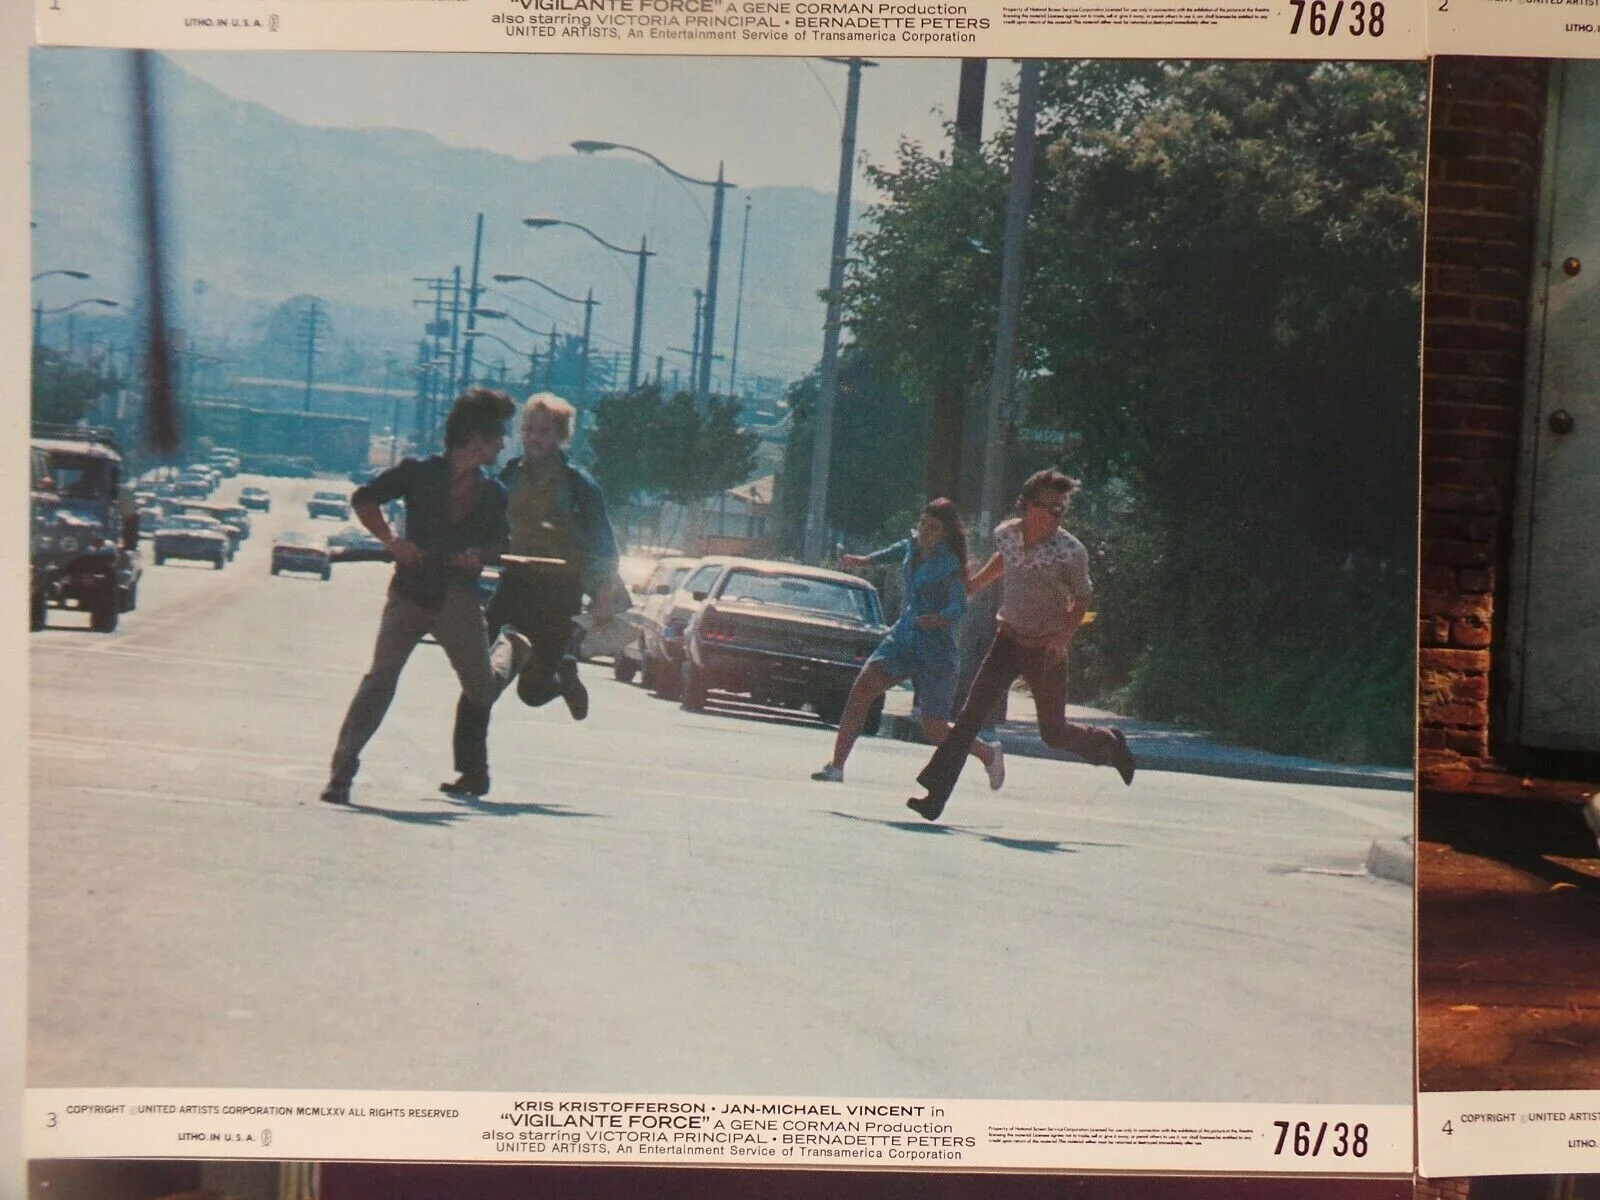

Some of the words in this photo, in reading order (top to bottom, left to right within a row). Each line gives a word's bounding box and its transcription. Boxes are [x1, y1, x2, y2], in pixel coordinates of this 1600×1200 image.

[726, 3, 738, 13] A
[743, 3, 791, 14] GENE
[796, 3, 873, 14] CORMAN
[879, 4, 967, 15] Production
[216, 18, 228, 26] IN
[492, 13, 524, 24] also
[529, 14, 591, 27] starring
[597, 14, 680, 26] VICTORIA
[685, 16, 780, 27] PRINCIPAL
[795, 17, 916, 28] BERNADETTE
[921, 18, 990, 29] PETERS
[1290, 1, 1385, 37] 76/38
[506, 26, 556, 36] UNITED
[562, 26, 621, 38] ARTISTS,
[628, 28, 644, 38] An
[650, 28, 736, 39] Entertainment
[742, 29, 788, 40] Service
[794, 30, 807, 40] of
[812, 30, 896, 41] Transamerica
[902, 30, 976, 43] Corporation
[66, 1105, 126, 1114] COPYRIGHT
[178, 1106, 220, 1114] ARTISTS
[222, 1106, 293, 1116] CORPORATION
[296, 1108, 346, 1116] MCMLXXV
[349, 1108, 366, 1116] ALL
[369, 1108, 406, 1117] RIGHTS
[408, 1109, 460, 1118] RESERVED
[514, 1101, 554, 1112] KRIS
[559, 1102, 706, 1113] KRISTOFFERSON
[721, 1104, 842, 1115] JAN-MICHAEL
[847, 1105, 925, 1116] VINCENT
[931, 1106, 945, 1117] in
[46, 1112, 58, 1128] 3
[1460, 1113, 1517, 1122] COPYRIGHT
[714, 1119, 726, 1130] A
[730, 1120, 778, 1130] GENE
[782, 1120, 860, 1132] CORMAN
[865, 1122, 953, 1133] Production
[1442, 1120, 1454, 1135] 4
[210, 1133, 220, 1141] IN
[482, 1129, 514, 1140] also
[519, 1130, 580, 1142] starring
[586, 1130, 668, 1142] VICTORIA
[674, 1132, 768, 1144] PRINCIPAL
[782, 1134, 902, 1146] BERNADETTE
[907, 1136, 976, 1147] PETERS
[1273, 1121, 1369, 1158] 76/38
[496, 1142, 546, 1152] UNITED
[552, 1143, 610, 1154] ARTISTS,
[616, 1144, 632, 1154] An
[640, 1144, 724, 1156] Entertainment
[730, 1145, 776, 1156] Service
[782, 1146, 794, 1156] of
[801, 1146, 883, 1158] Transamerica
[889, 1148, 962, 1160] Corporation
